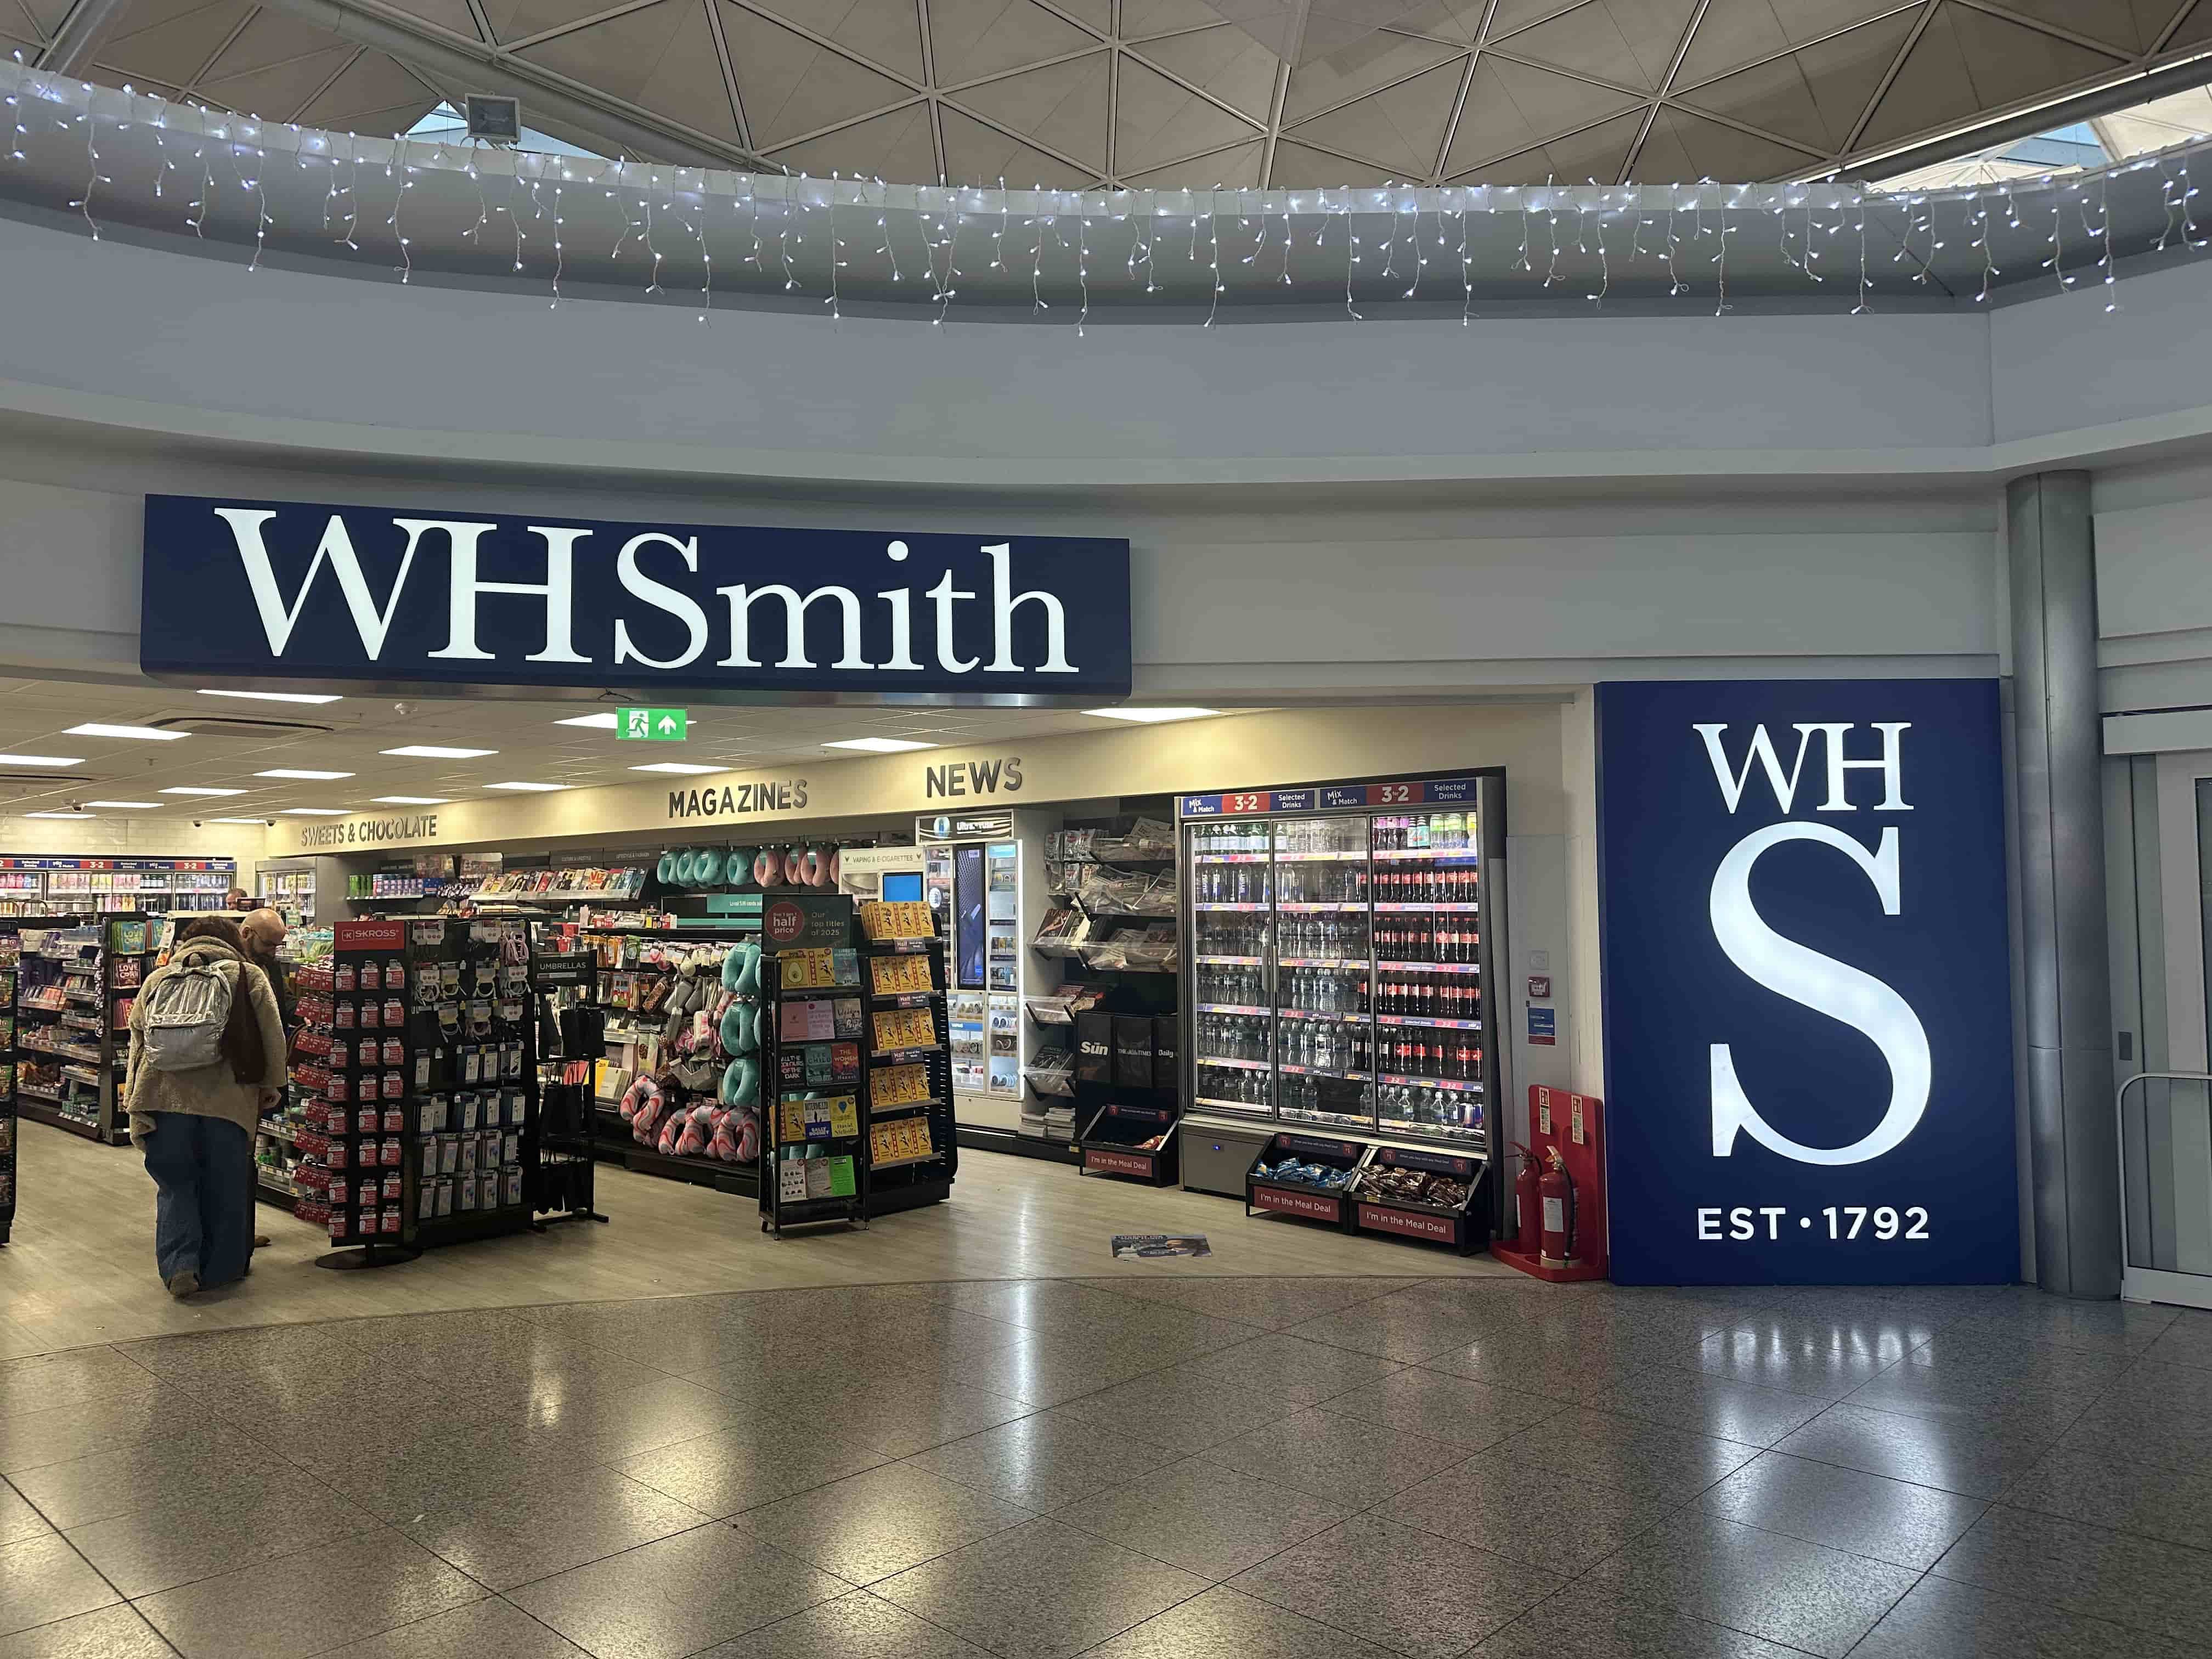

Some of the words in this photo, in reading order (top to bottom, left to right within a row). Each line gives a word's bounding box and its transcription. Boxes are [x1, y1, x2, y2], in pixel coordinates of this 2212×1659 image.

[213, 506, 1080, 673] WHSmith
[1692, 722, 1914, 814] WH
[926, 757, 1023, 798] NEWS
[1327, 790, 1342, 800] Mix
[1434, 783, 1466, 792] Selected
[669, 779, 808, 818] MAGAZINES
[1189, 799, 1201, 808] Mix
[1438, 792, 1462, 800] Drinks
[301, 823, 345, 847] SWEETS
[348, 823, 356, 843] &
[359, 815, 437, 842] CHOCOLATE
[773, 916, 797, 927] half
[119, 964, 138, 972] LOVE
[540, 962, 586, 970] UMBRELLAS
[1709, 821, 1932, 1165] S
[1080, 1041, 1108, 1056] Sun
[1158, 1049, 1173, 1058] Daily
[1281, 1197, 1293, 1206] the
[1295, 1199, 1312, 1209] Meal
[1314, 1203, 1330, 1212] Deal
[1367, 1211, 1378, 1221] I'm
[1381, 1213, 1388, 1222] in
[1390, 1216, 1403, 1226] the
[1406, 1219, 1425, 1229] Meal
[1427, 1222, 1446, 1233] Deal
[1697, 1206, 1787, 1240] EST
[1821, 1206, 1930, 1240] 1792
